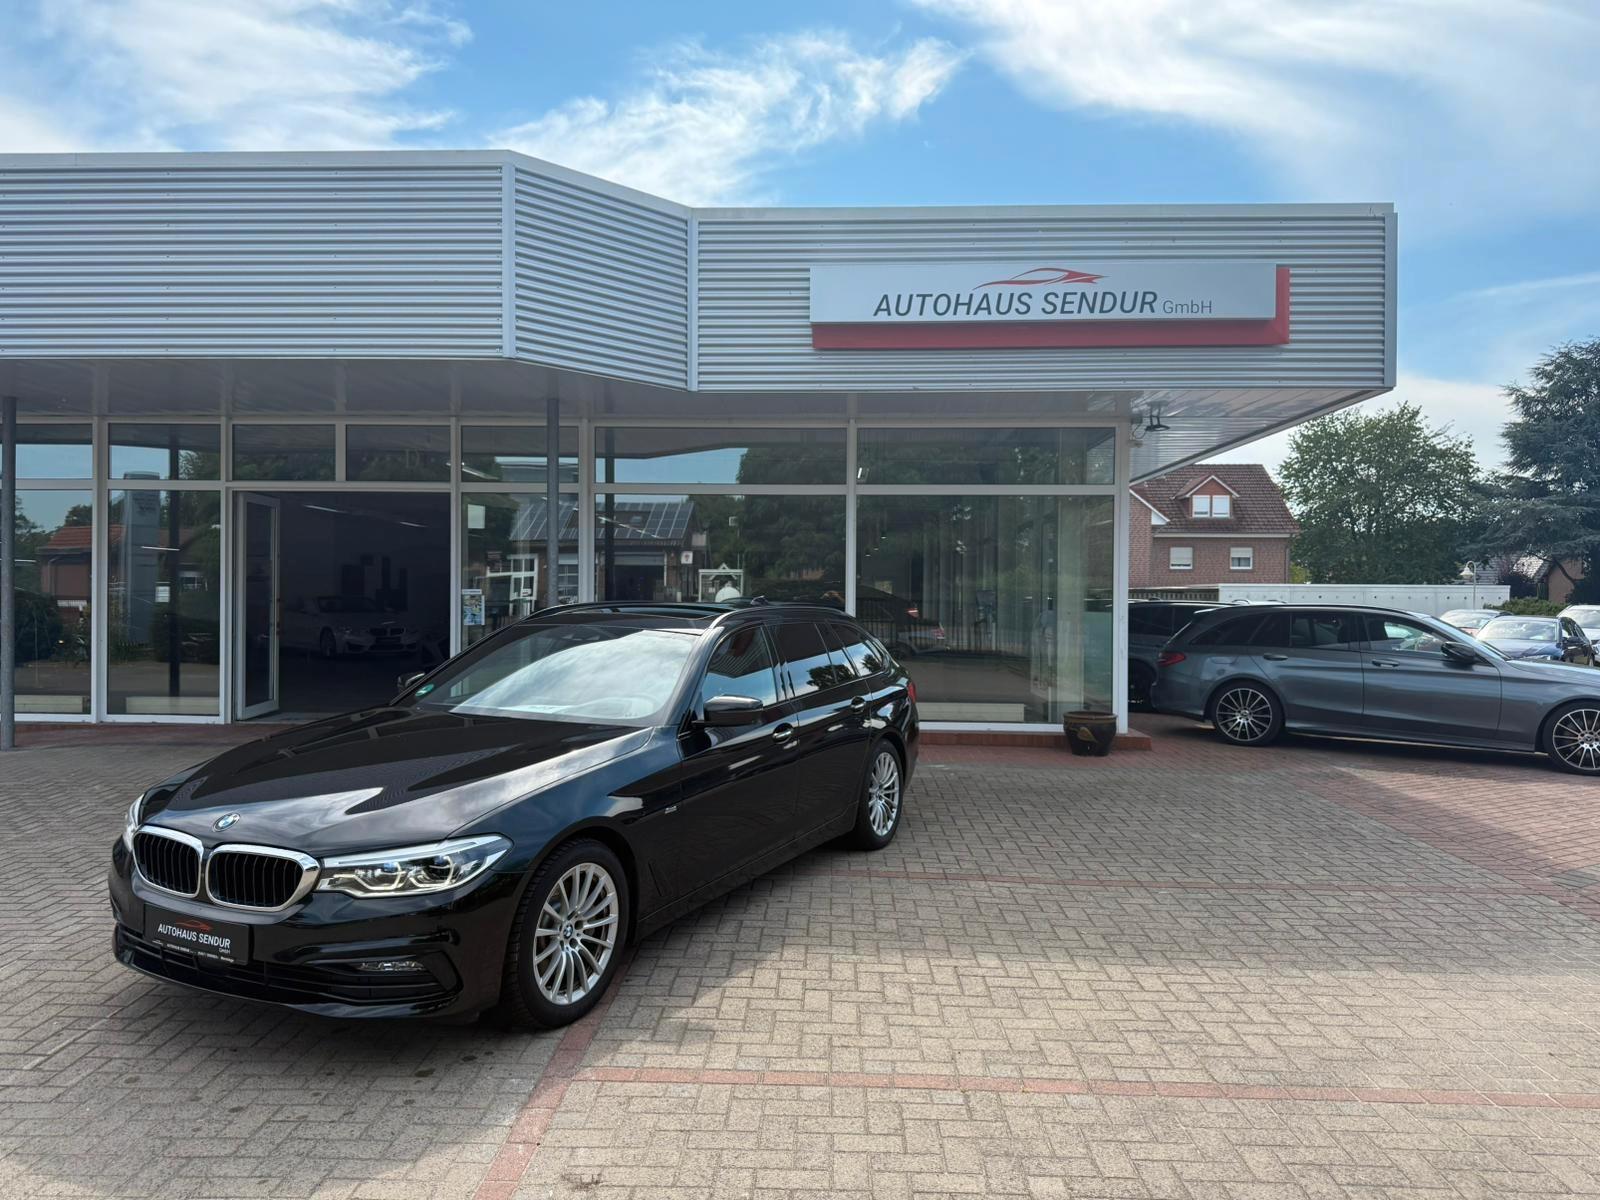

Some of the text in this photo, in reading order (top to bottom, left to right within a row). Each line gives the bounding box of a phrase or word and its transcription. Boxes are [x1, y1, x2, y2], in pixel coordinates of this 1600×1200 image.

[873, 291, 1213, 317] AUTOHAUS SENDUR GmbH
[157, 924, 197, 941] AUTOHAUS
[198, 933, 231, 949] SENDUR
